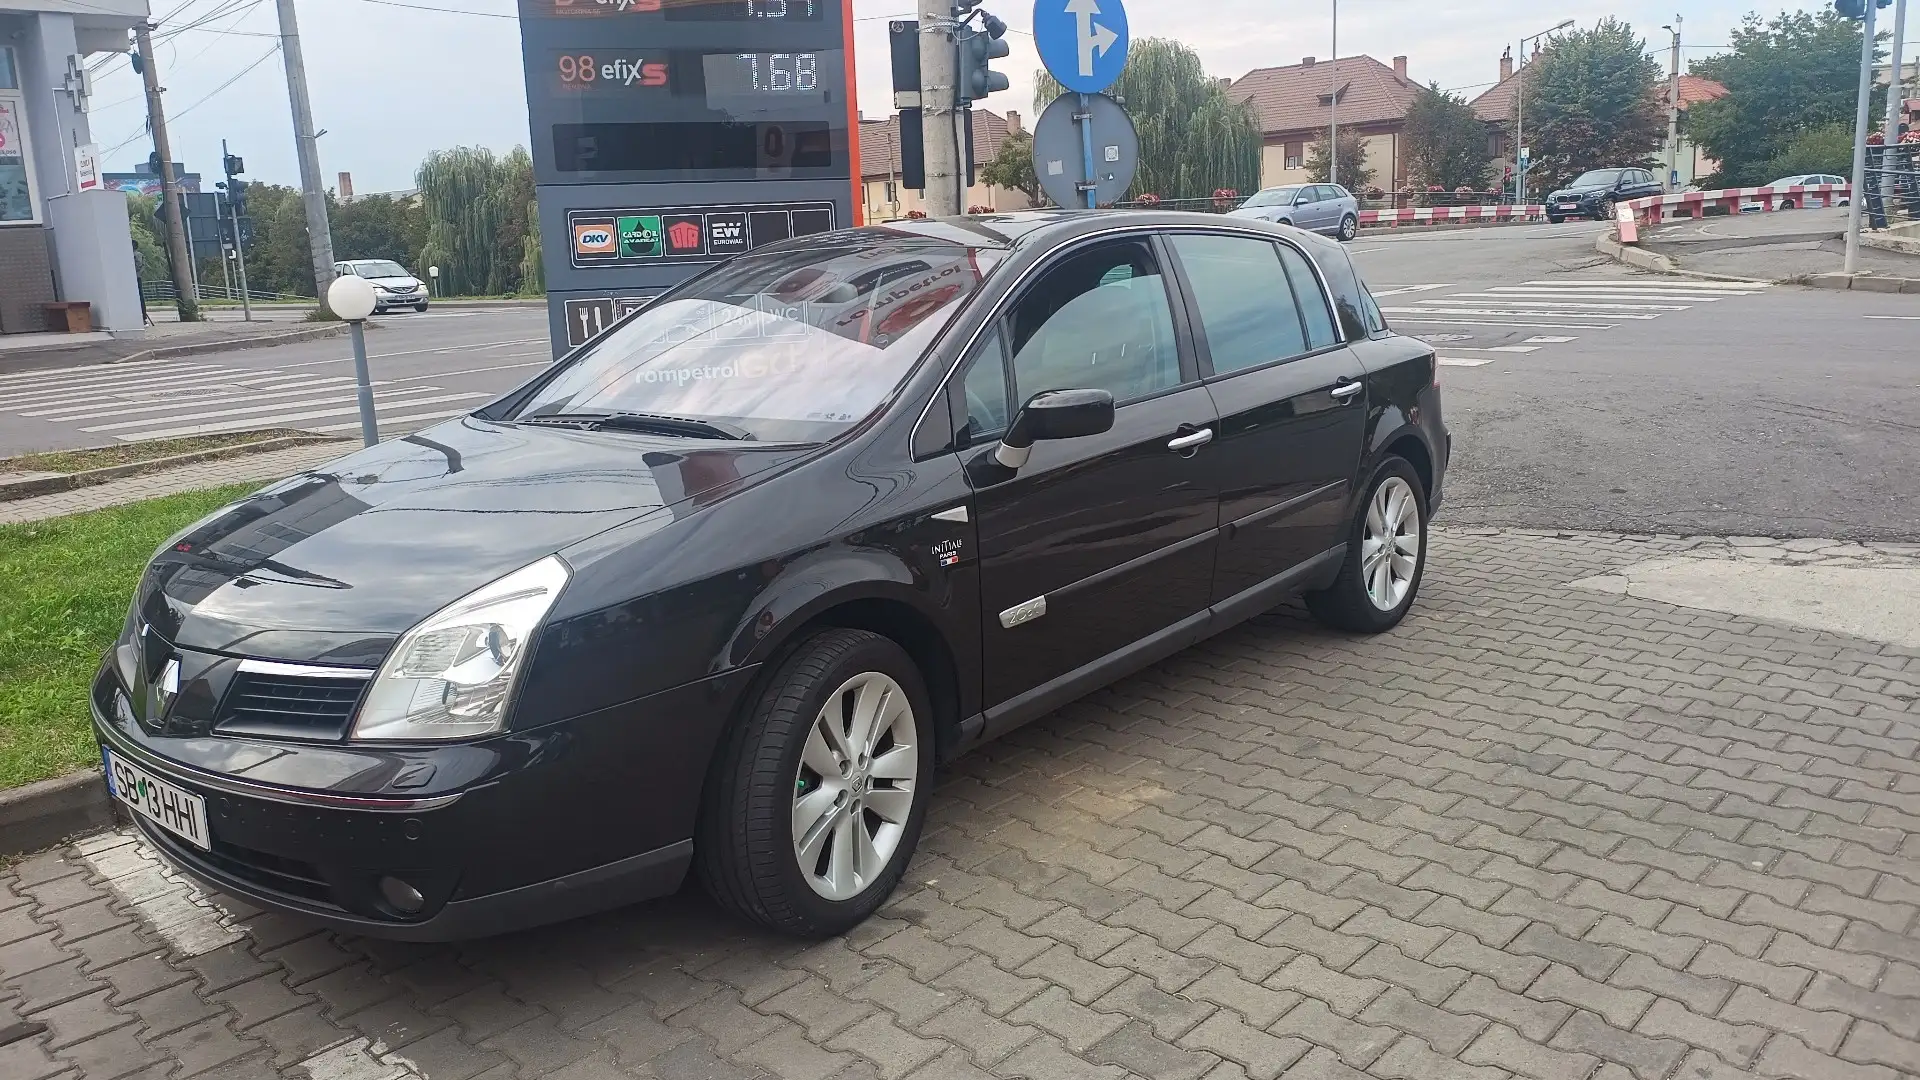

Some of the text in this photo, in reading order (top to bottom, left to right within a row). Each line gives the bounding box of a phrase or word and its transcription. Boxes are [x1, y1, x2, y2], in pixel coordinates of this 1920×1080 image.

[559, 55, 596, 82] 98
[736, 53, 817, 91] 7.68
[582, 233, 609, 244] DKV
[769, 307, 799, 321] WC
[635, 359, 739, 387] rompetrol
[931, 538, 963, 555] INITIALE
[939, 550, 957, 560] PARIS
[114, 760, 140, 805] SB
